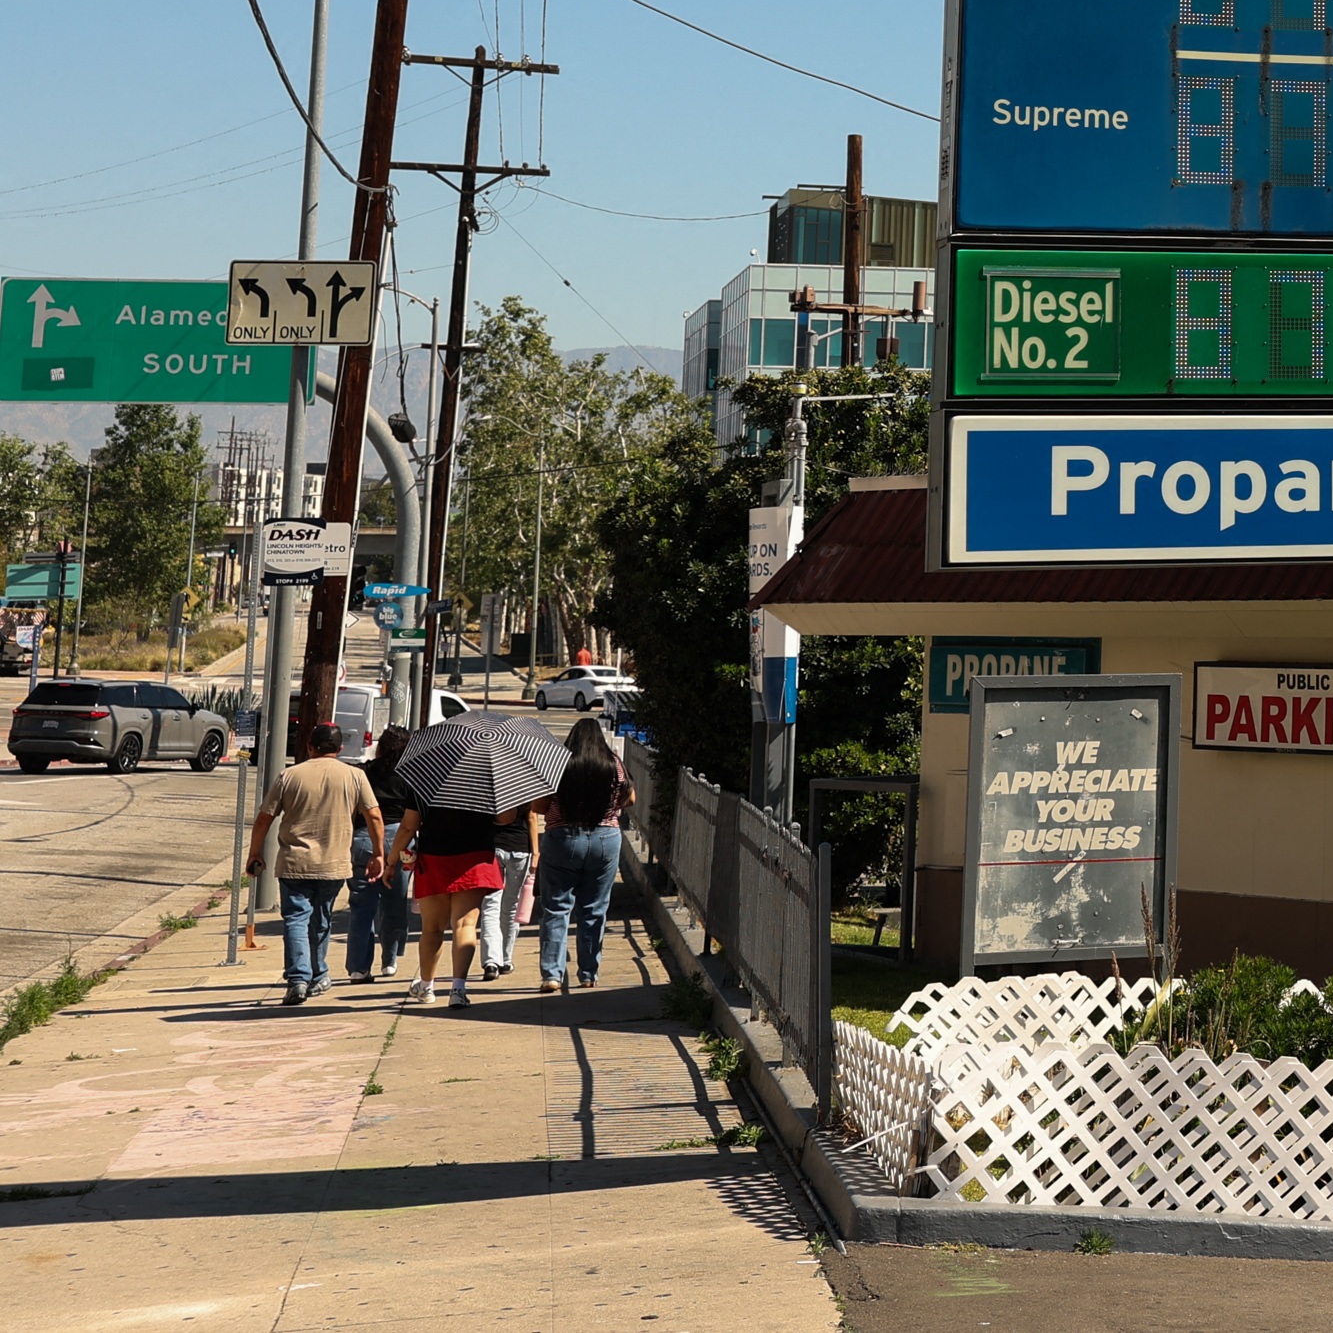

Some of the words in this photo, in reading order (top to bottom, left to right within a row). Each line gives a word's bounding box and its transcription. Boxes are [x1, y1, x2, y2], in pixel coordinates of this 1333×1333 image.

[991, 98, 1130, 132] Supreme
[992, 280, 1115, 325] Diesel
[233, 326, 270, 340] ONLY
[279, 325, 316, 340] ONLY
[992, 327, 1057, 370] No.
[1063, 326, 1090, 370] 2
[142, 353, 251, 376] SOUTH
[268, 529, 321, 541] DASH
[760, 543, 778, 558] ON
[372, 585, 408, 596] Rapid
[382, 606, 394, 614] big
[1276, 673, 1331, 691] PUBLIC
[1056, 741, 1101, 764] WE
[986, 768, 1160, 795] APPRECIATE
[1036, 798, 1115, 823] YOUR
[1003, 826, 1142, 853] BUSINESS
